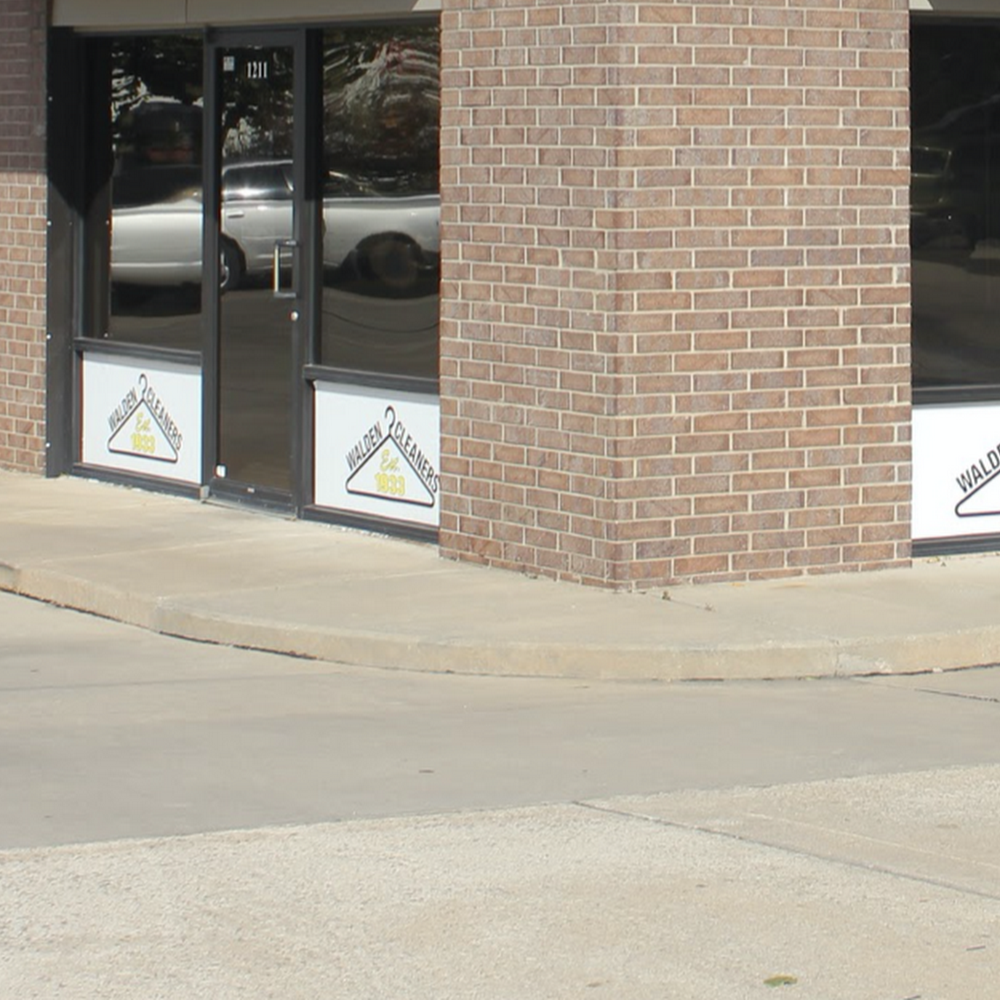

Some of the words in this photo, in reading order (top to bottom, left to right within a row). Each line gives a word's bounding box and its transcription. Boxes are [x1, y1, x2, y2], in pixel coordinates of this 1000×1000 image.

[247, 61, 267, 79] 1211
[107, 387, 137, 432] WALDEN
[147, 386, 183, 451] CLEANERS
[345, 421, 383, 471] WALDEN
[394, 421, 440, 493] CLEANERS
[374, 472, 406, 496] 1933
